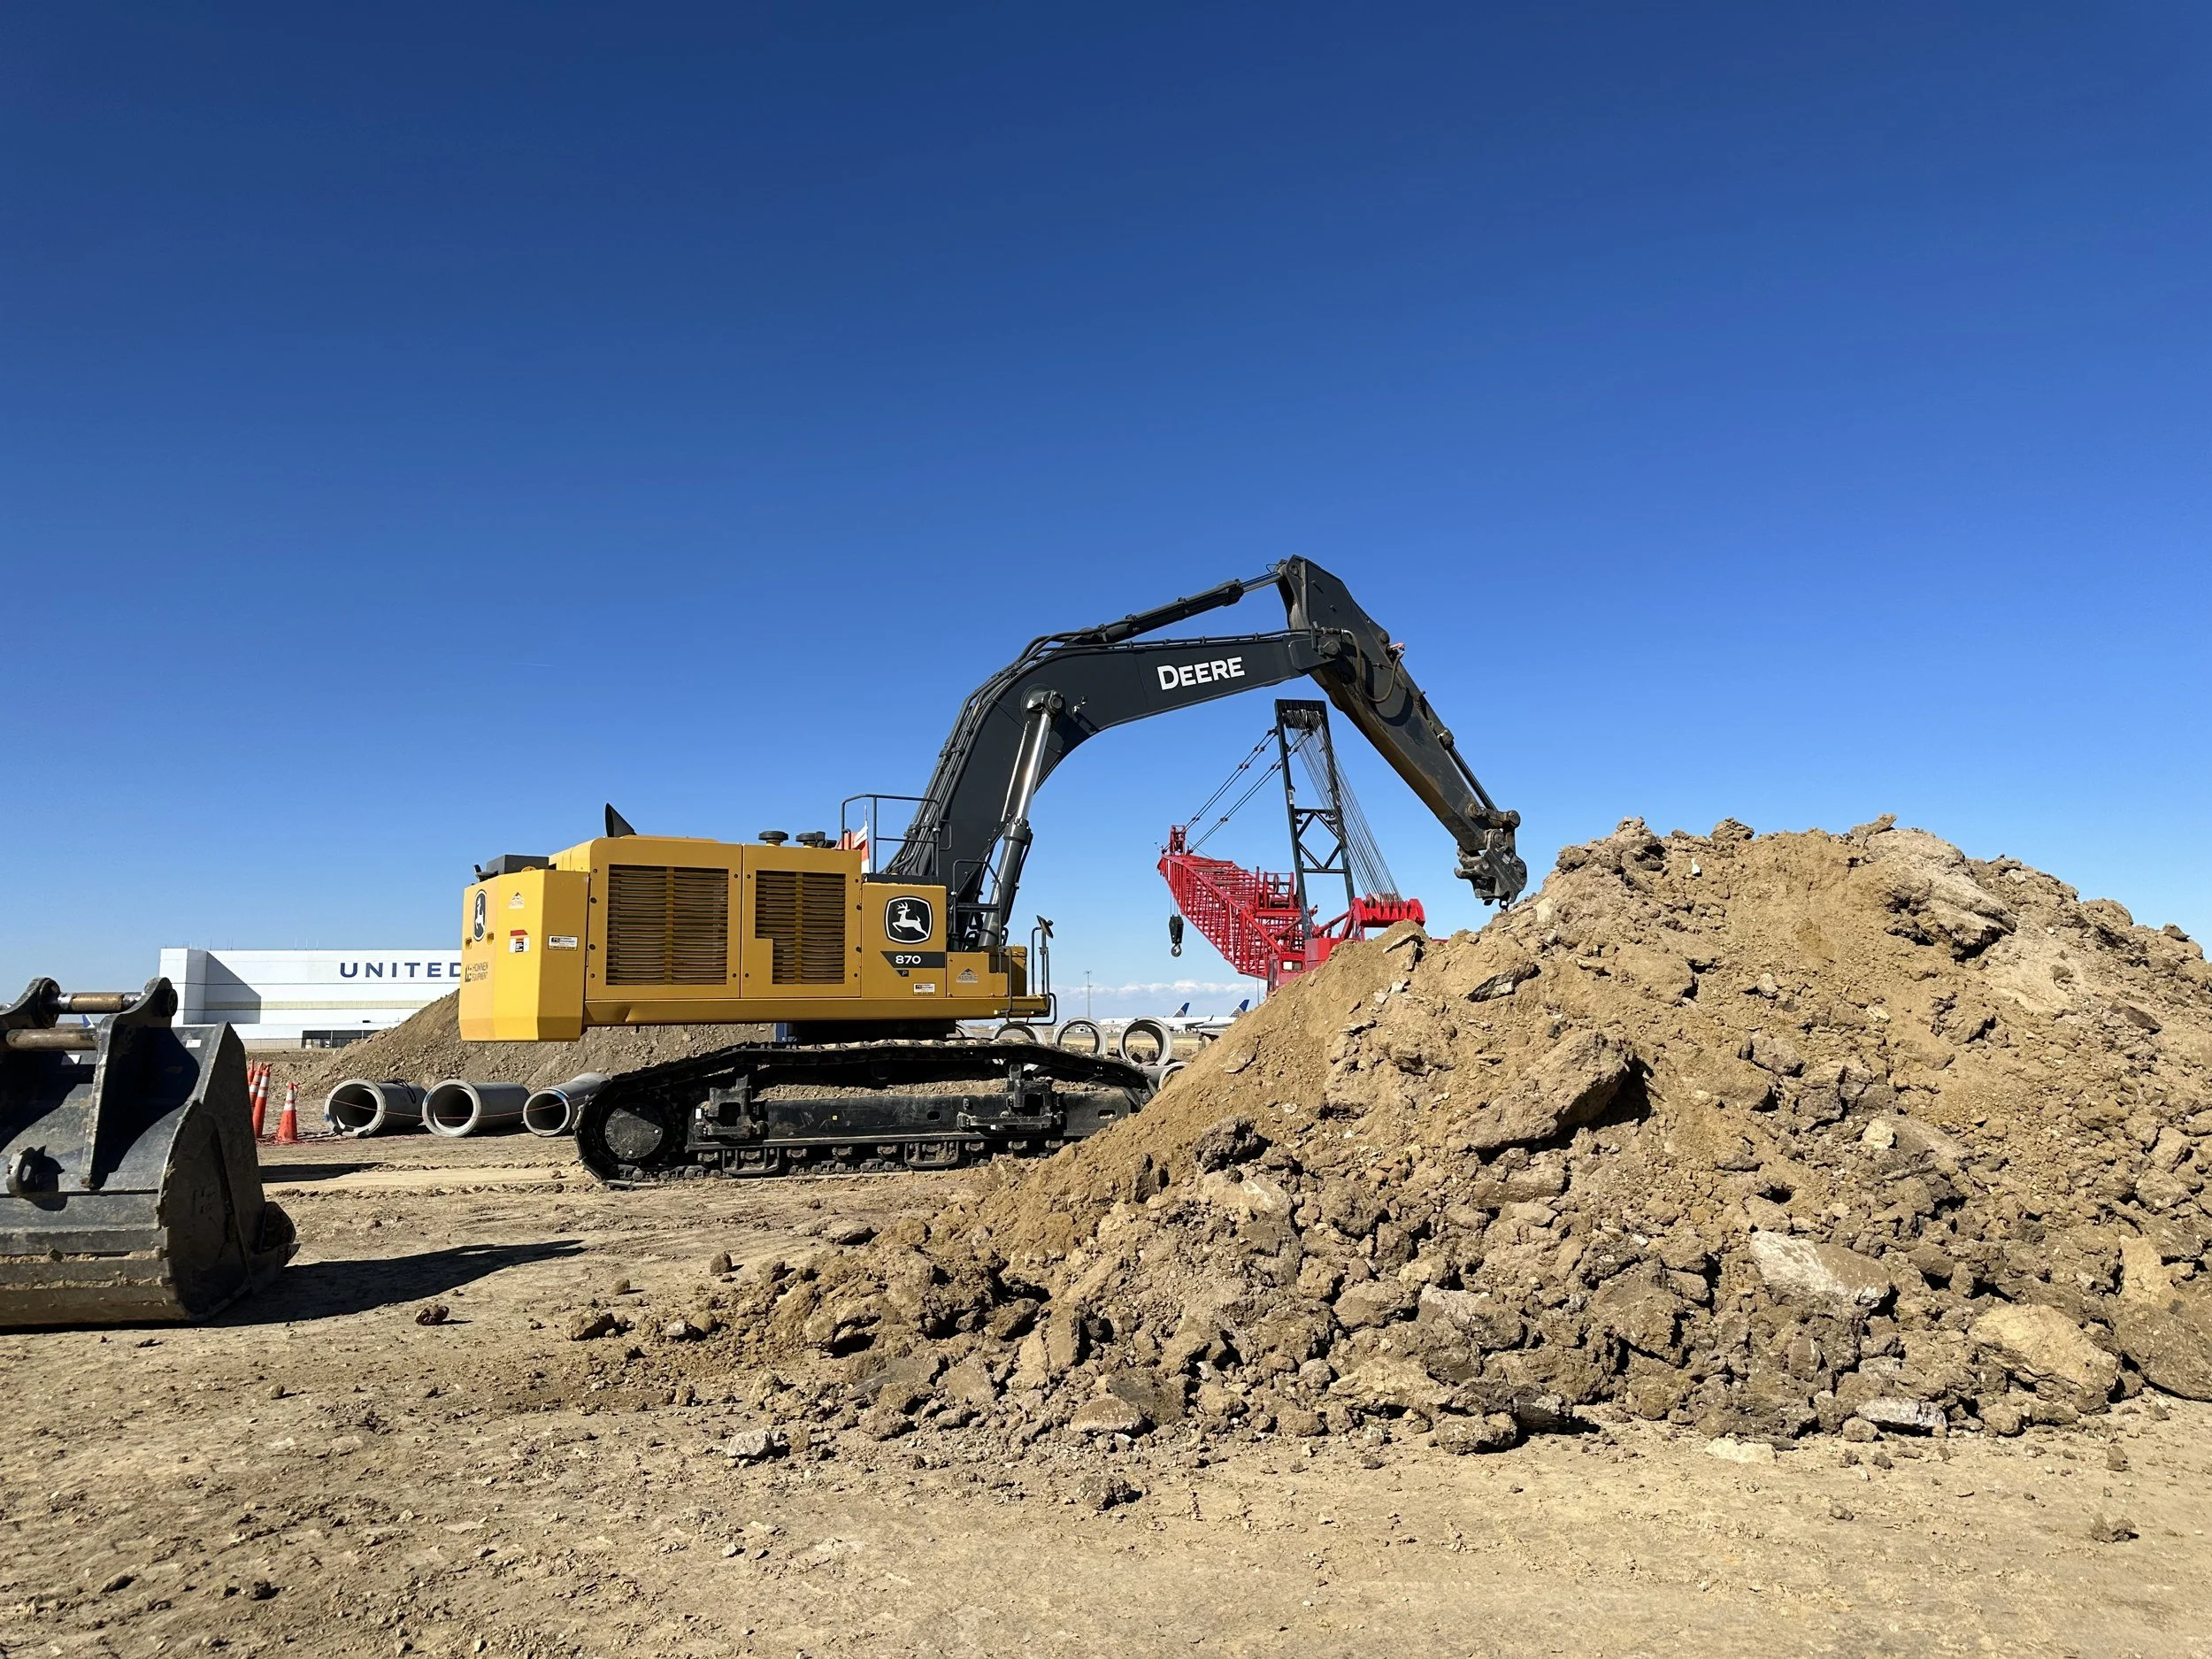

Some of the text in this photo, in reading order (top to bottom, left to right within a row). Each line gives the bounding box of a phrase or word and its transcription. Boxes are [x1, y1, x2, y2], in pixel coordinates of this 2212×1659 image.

[1156, 657, 1246, 690] DEERE
[895, 955, 921, 964] 870
[340, 962, 461, 978] UNITED
